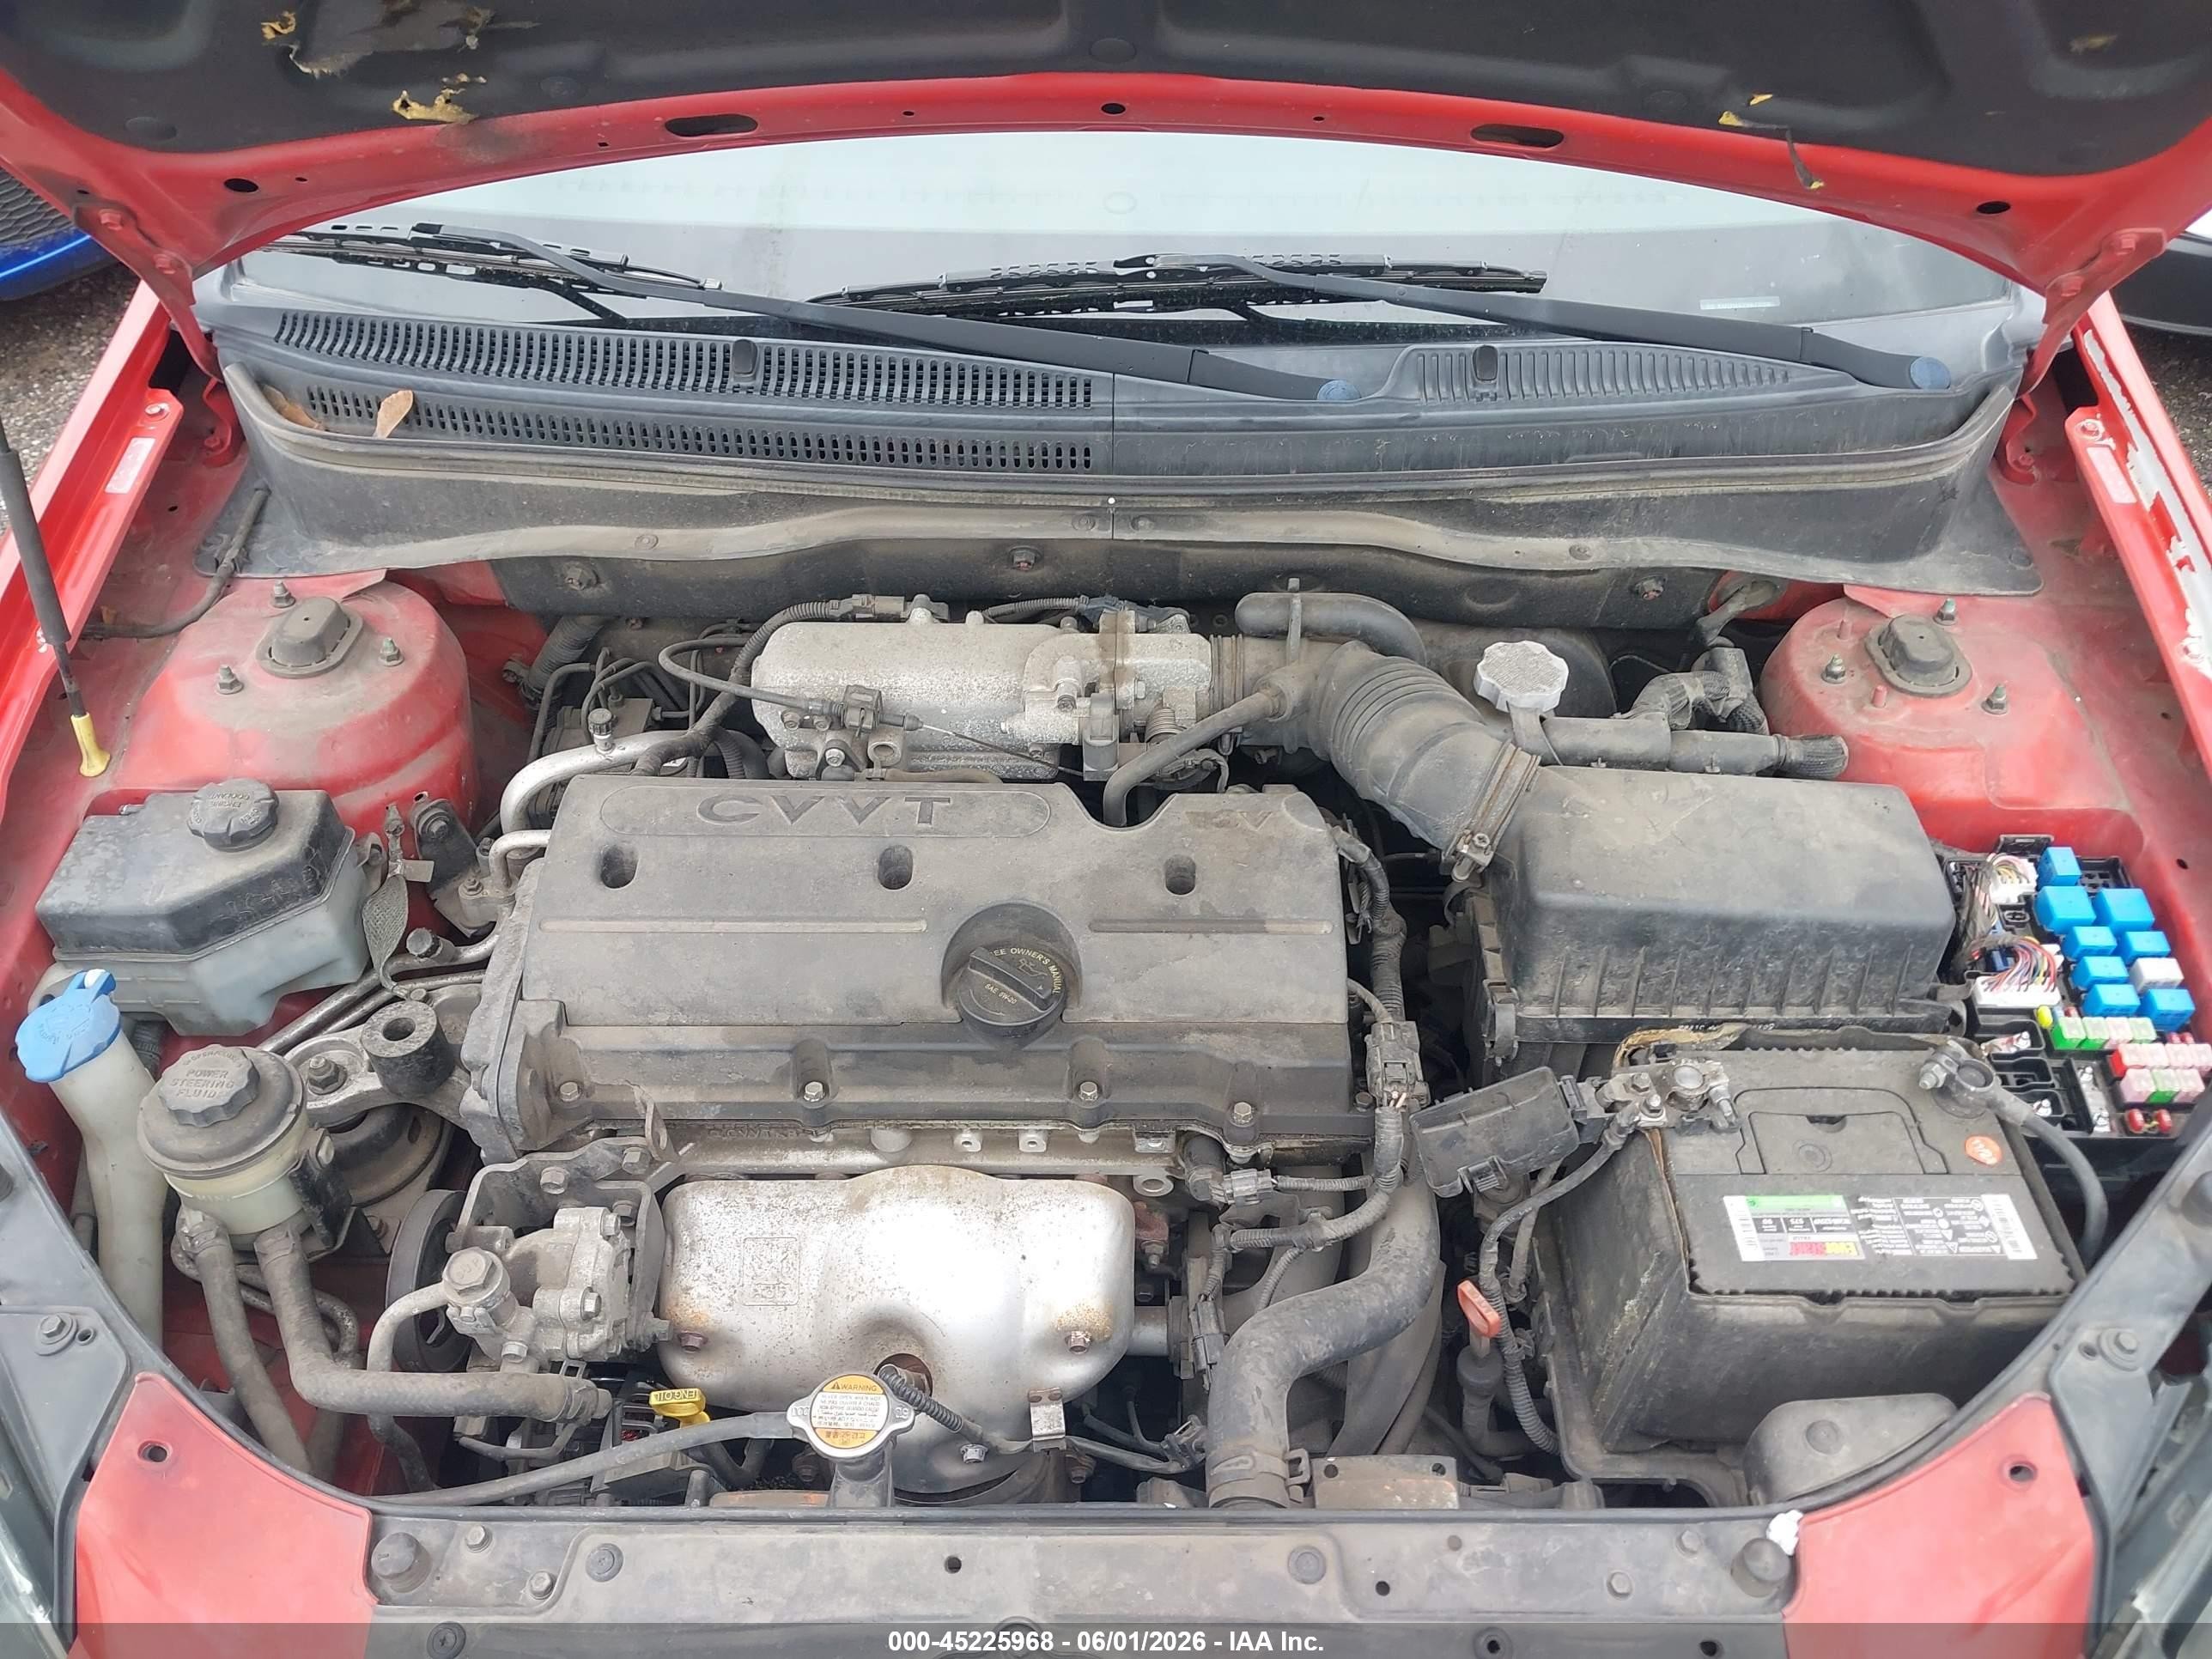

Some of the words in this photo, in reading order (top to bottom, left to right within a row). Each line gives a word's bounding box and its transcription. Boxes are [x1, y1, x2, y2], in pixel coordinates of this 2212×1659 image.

[697, 793, 951, 825] CVVT
[1010, 947, 1050, 965] OWNER'S
[1048, 964, 1062, 995] MANUAL
[984, 983, 999, 994] SAE
[185, 1069, 228, 1079] POWER
[171, 1078, 234, 1089] STEERING
[176, 1088, 217, 1098] FLUID
[841, 1382, 878, 1392] WARNING
